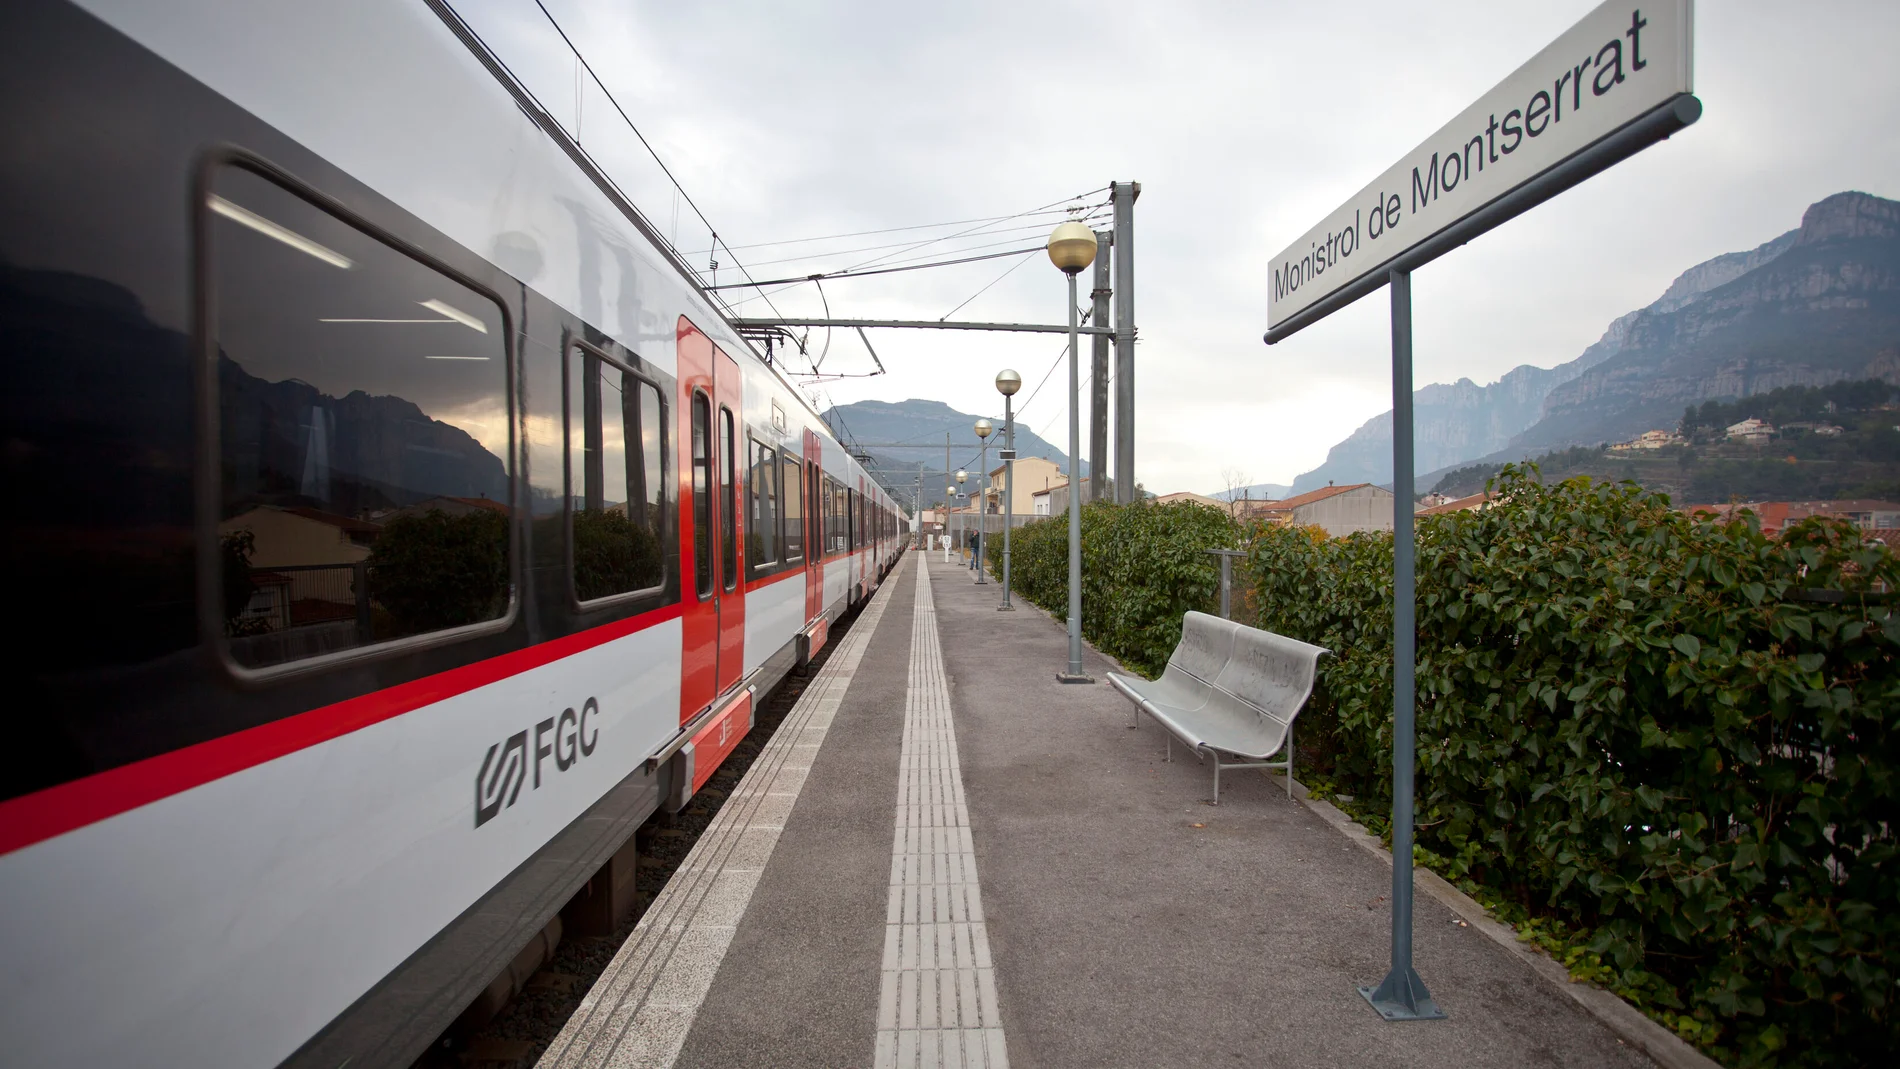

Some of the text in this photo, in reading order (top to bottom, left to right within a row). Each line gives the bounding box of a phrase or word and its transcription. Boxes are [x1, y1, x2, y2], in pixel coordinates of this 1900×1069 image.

[1275, 9, 1647, 302] Monistrol de Montserrat
[533, 696, 599, 790] FGC
